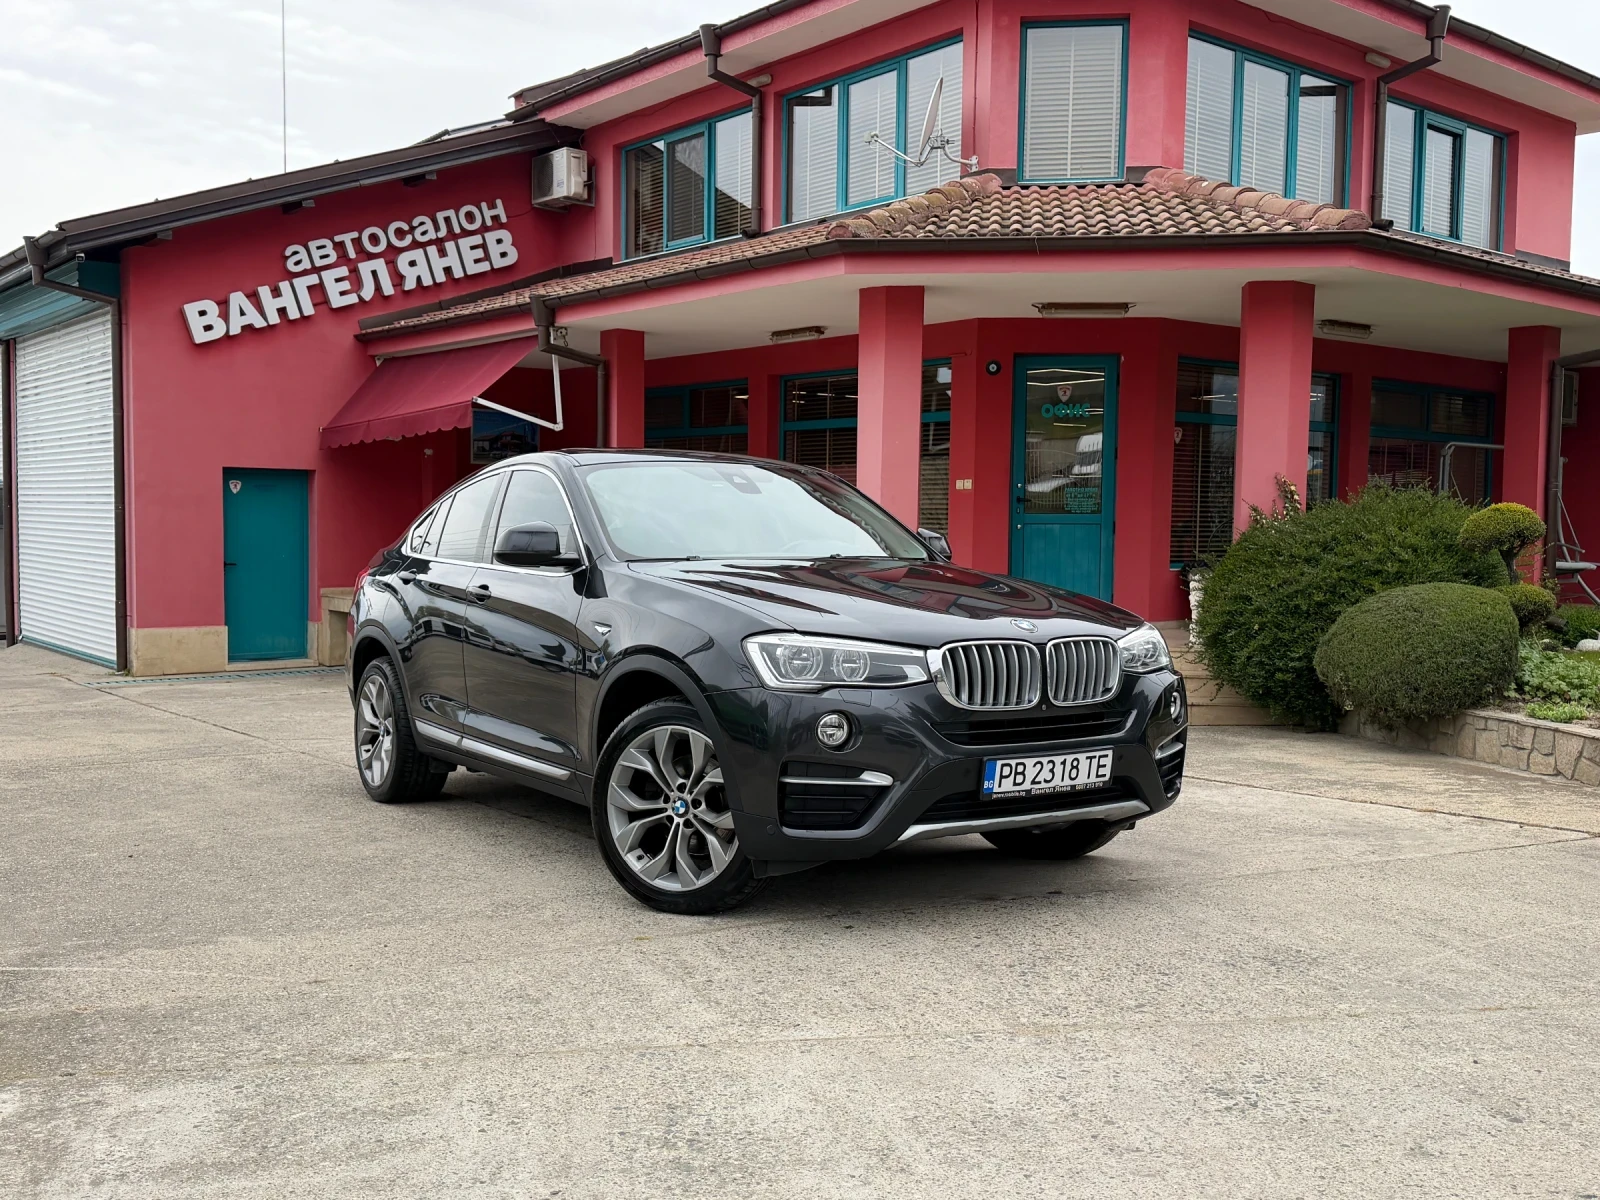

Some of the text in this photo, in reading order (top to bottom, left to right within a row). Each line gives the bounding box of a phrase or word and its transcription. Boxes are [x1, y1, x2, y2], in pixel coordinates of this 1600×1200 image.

[283, 199, 508, 273] автосалон
[182, 229, 518, 344] ВАНГЕЛ ЯНЕВ
[1041, 403, 1091, 418] ОФИС
[984, 780, 994, 789] BG
[998, 754, 1109, 788] PB 2318 TE
